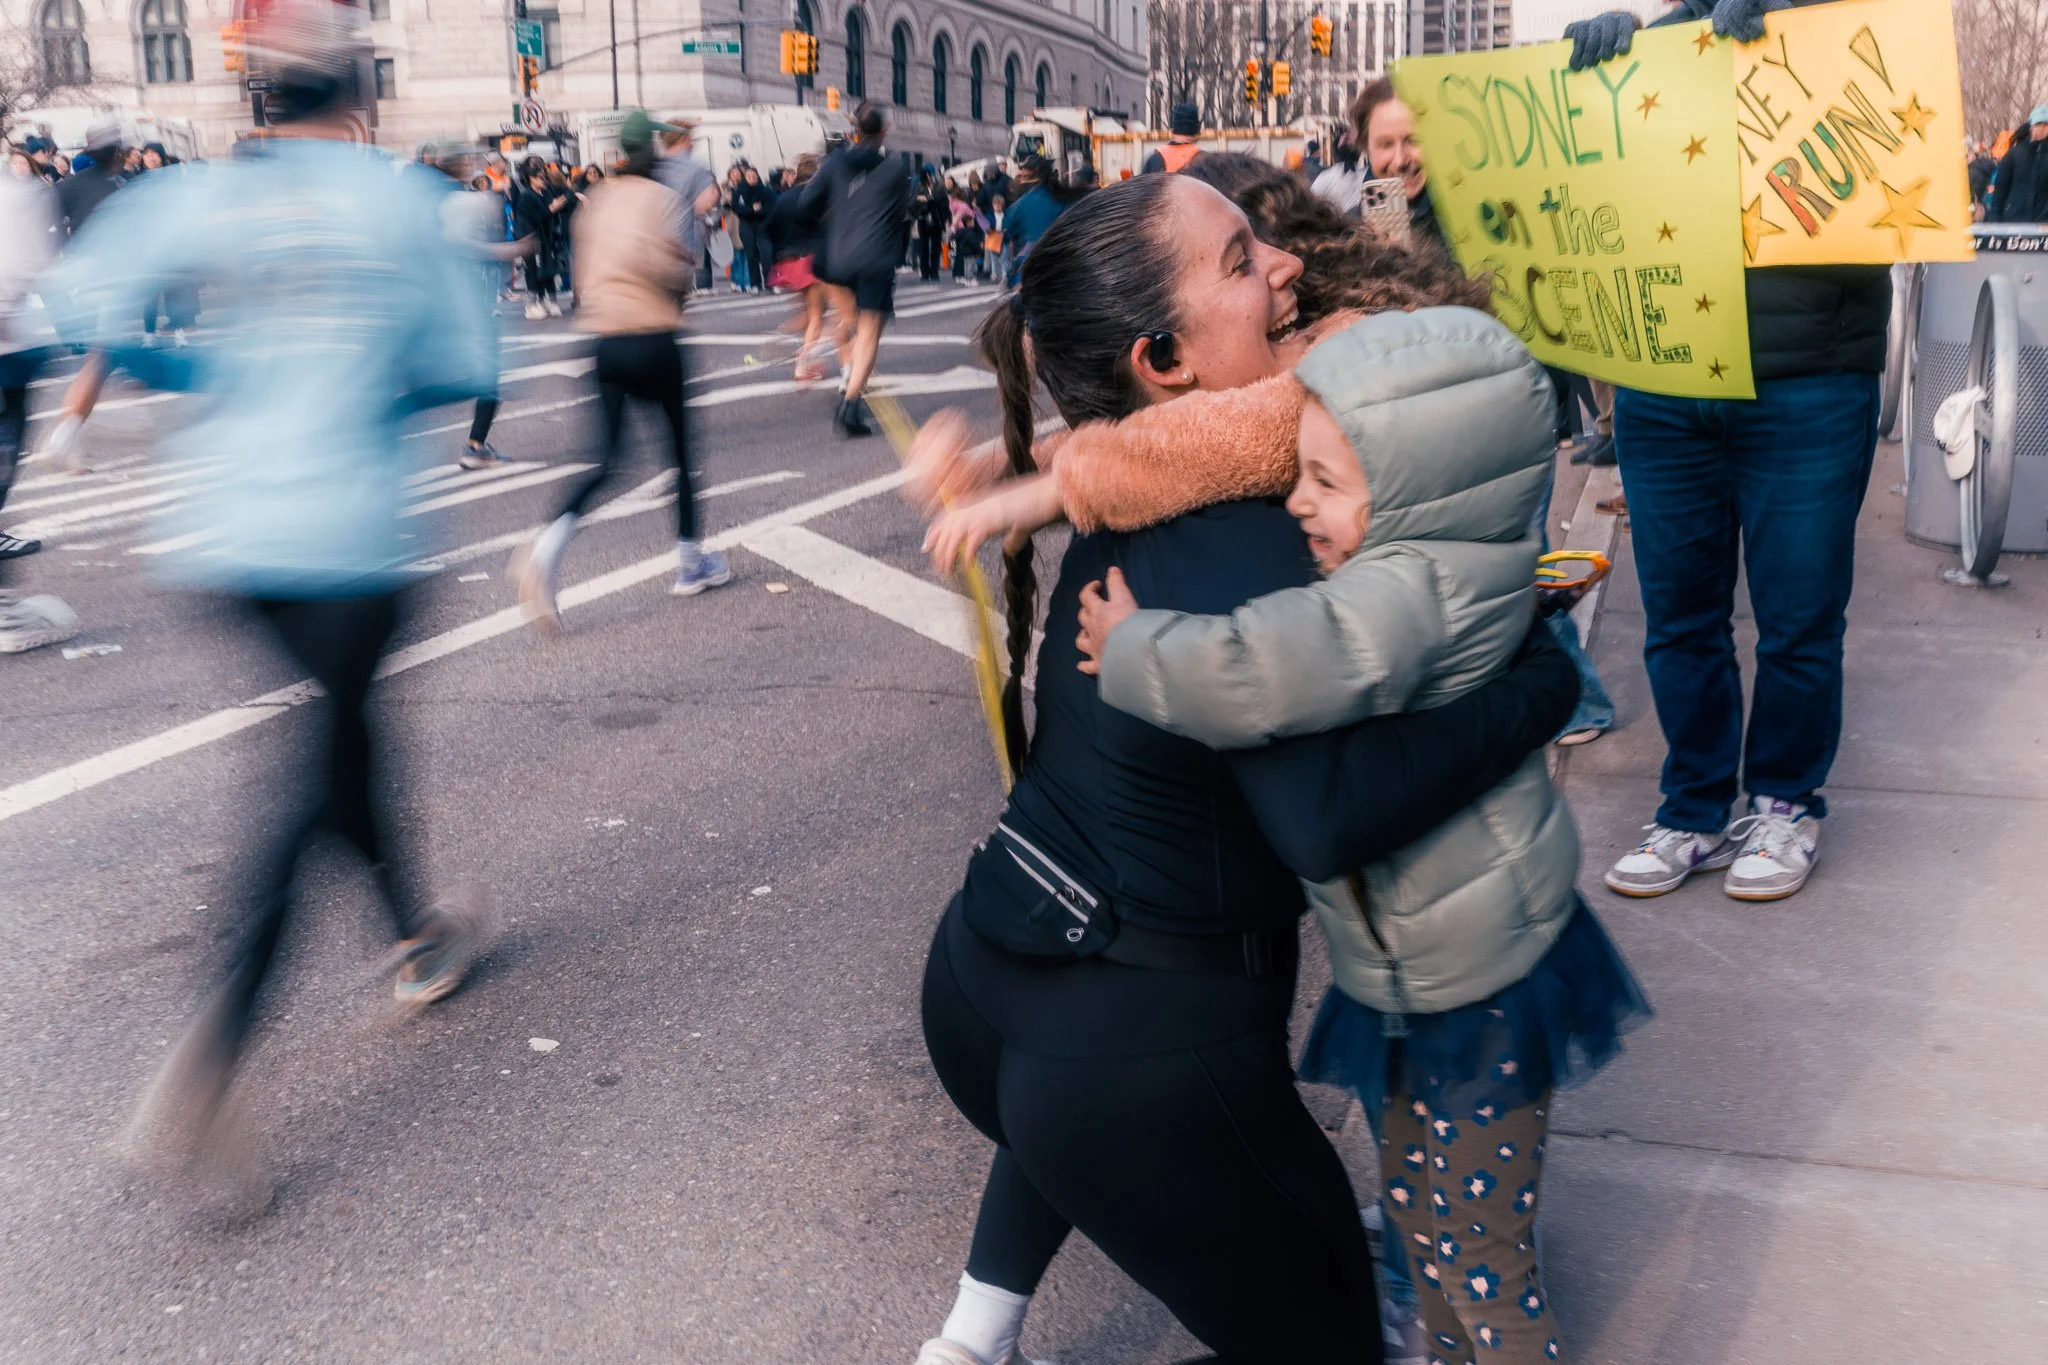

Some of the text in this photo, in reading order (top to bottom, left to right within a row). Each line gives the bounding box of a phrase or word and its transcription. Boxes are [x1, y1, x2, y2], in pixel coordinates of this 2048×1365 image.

[1439, 60, 1641, 171] SYDNEY
[1478, 183, 1625, 256] on the
[1470, 255, 1694, 365] SCENE
